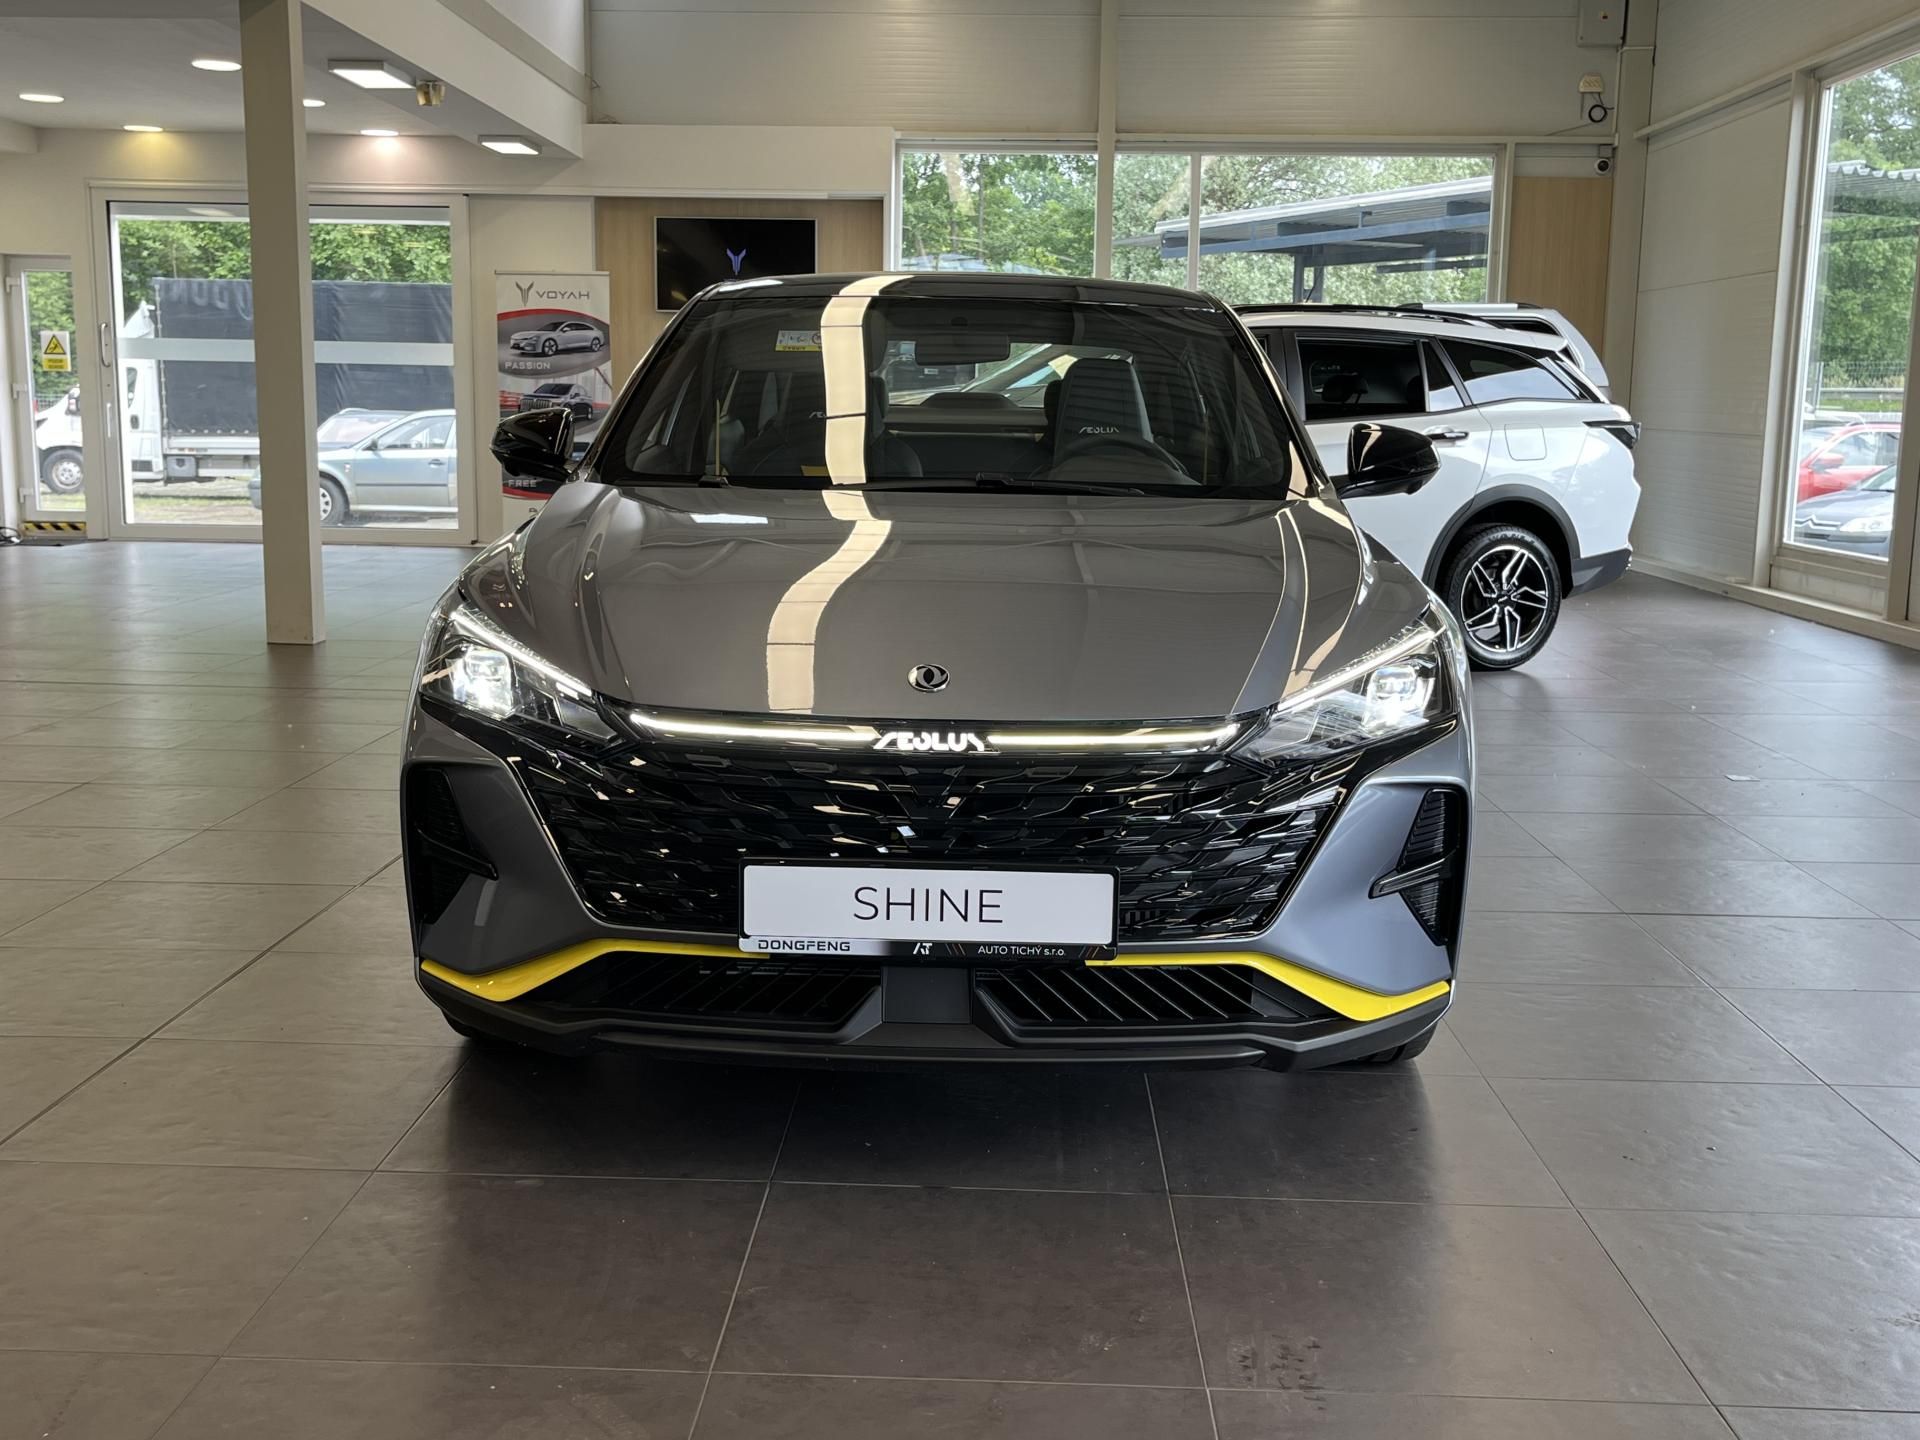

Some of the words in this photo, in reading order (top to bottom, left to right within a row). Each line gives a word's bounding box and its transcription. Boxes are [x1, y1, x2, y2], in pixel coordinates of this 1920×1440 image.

[535, 290, 590, 300] VOYAH
[505, 361, 551, 370] PASSION
[508, 479, 537, 488] FREE
[853, 886, 1004, 924] SHINE
[758, 939, 851, 952] DONGFENG
[978, 945, 1008, 955] AUTO
[1010, 944, 1042, 956] TICHÝ
